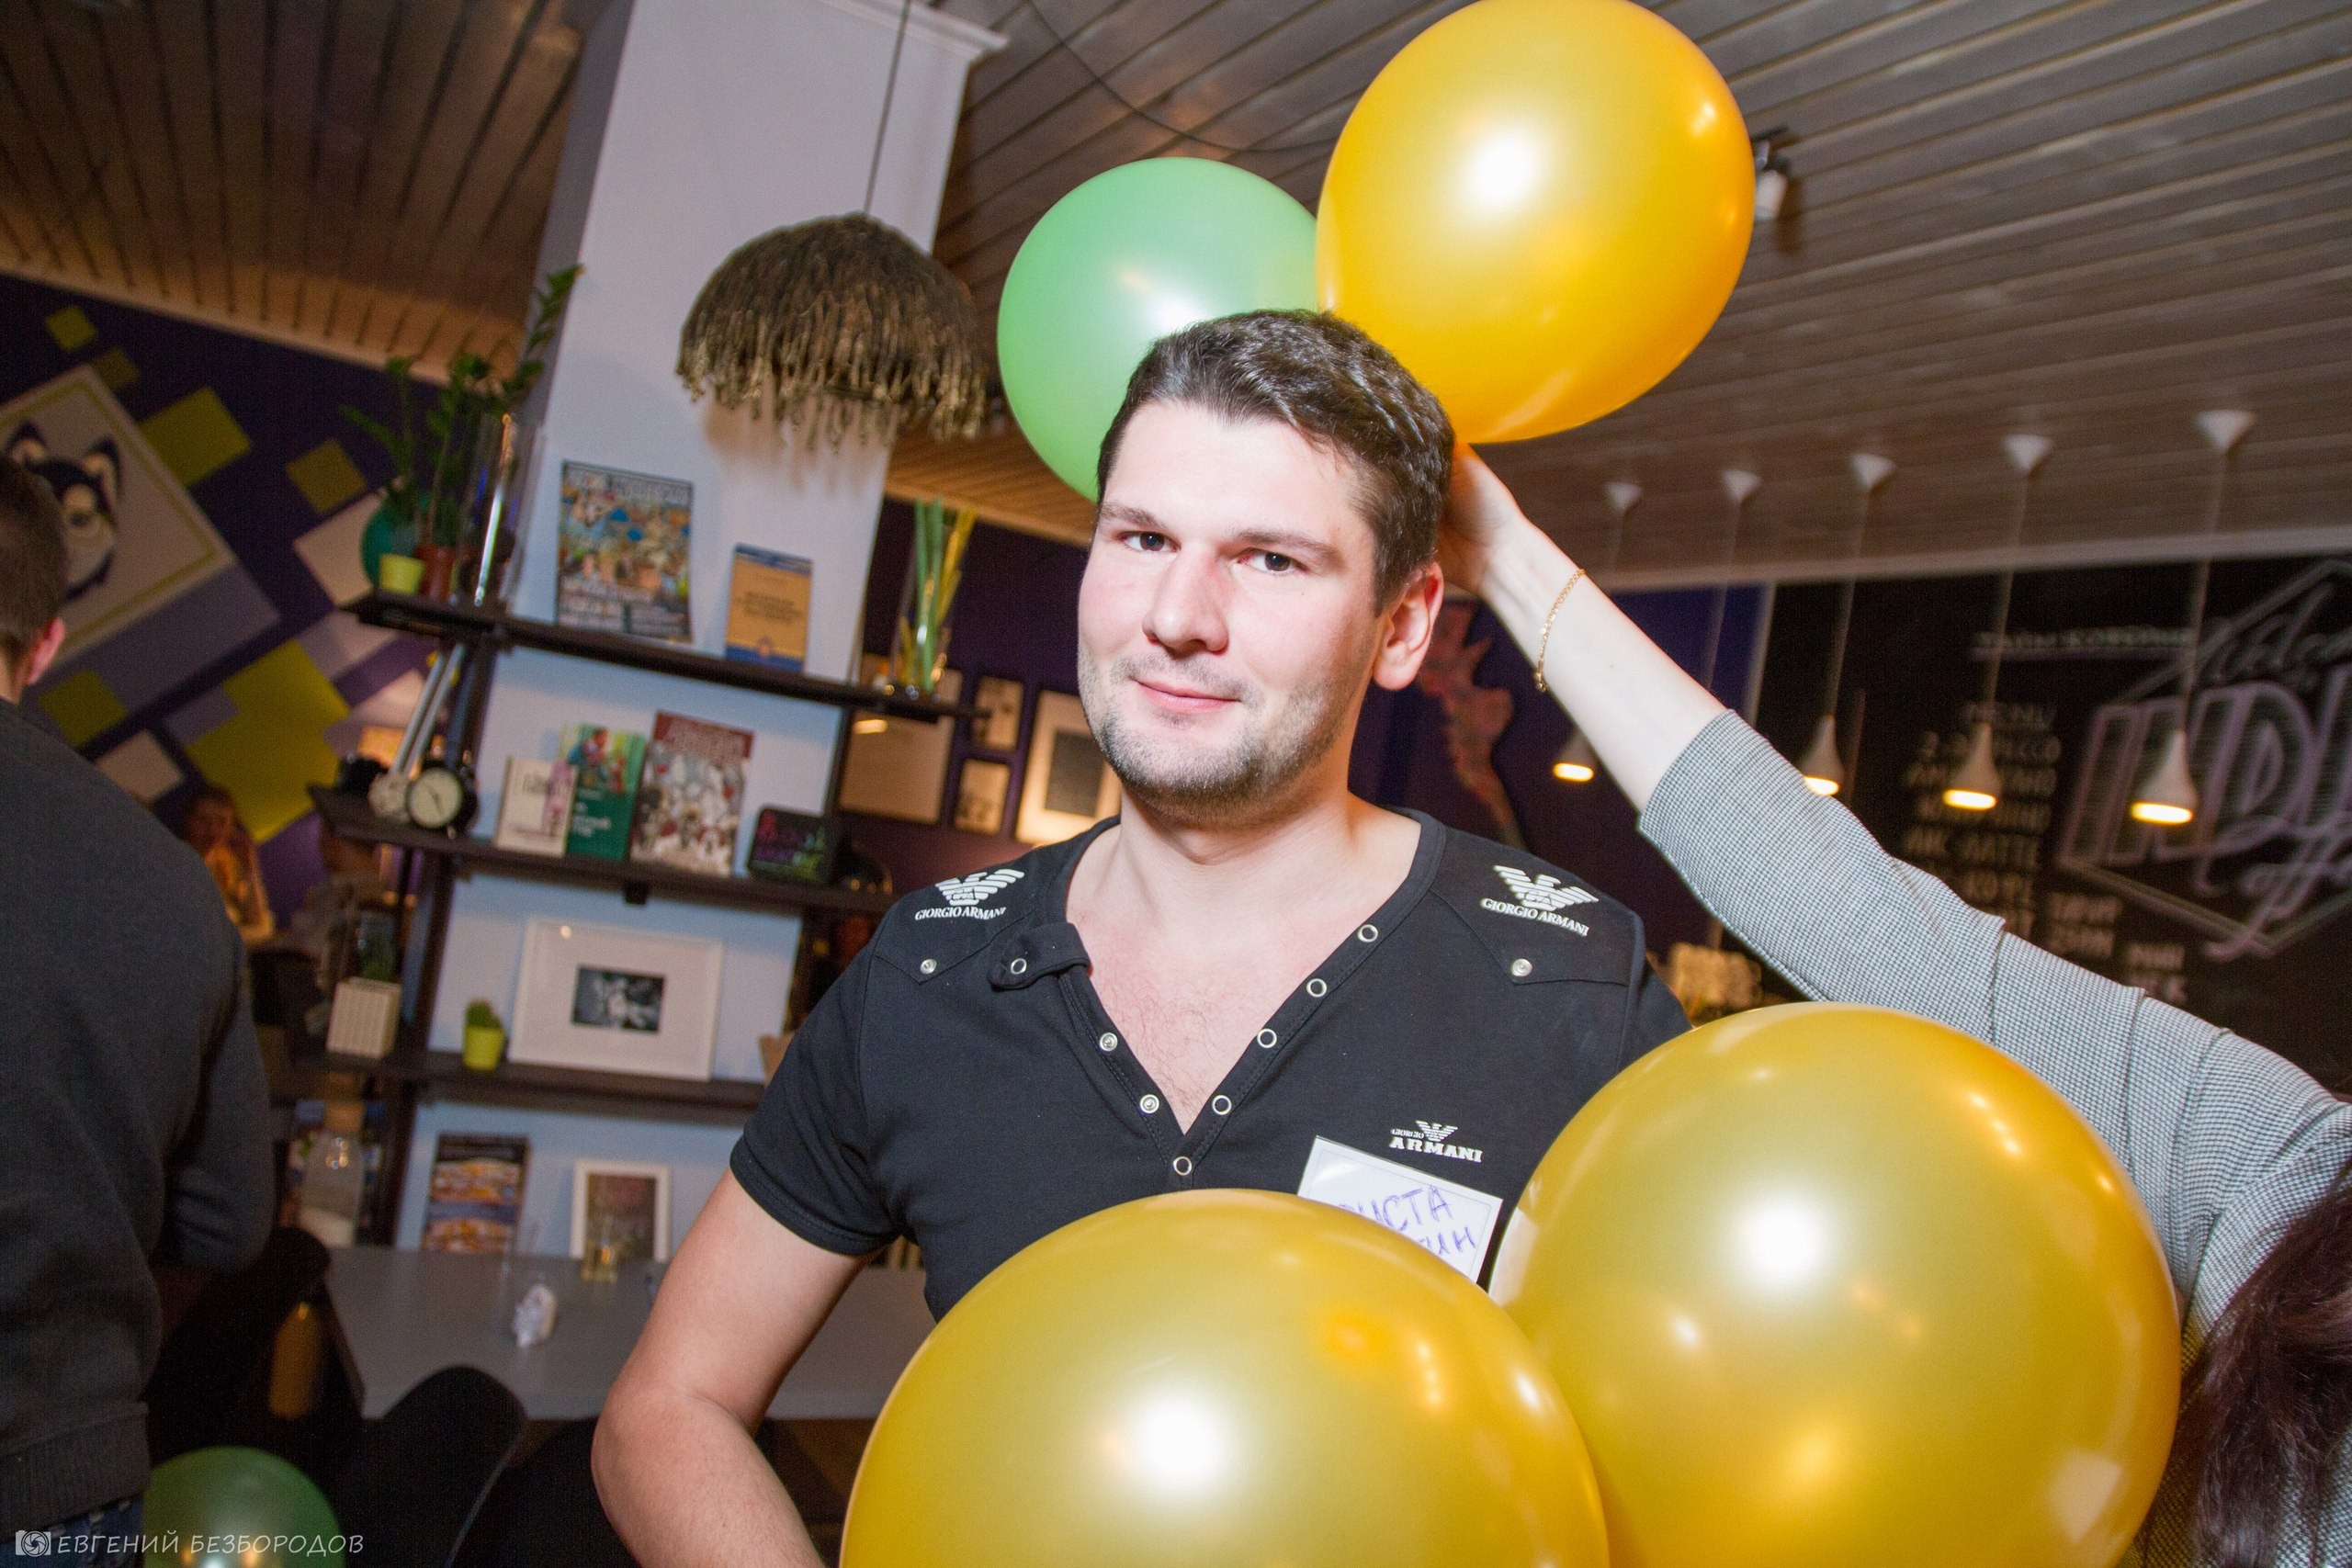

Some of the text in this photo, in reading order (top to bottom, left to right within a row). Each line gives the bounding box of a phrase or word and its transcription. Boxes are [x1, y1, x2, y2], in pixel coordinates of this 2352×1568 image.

[915, 907, 1007, 920] GIORGIO ARMANI
[1480, 897, 1589, 936] GIORGIO ARMANI
[1391, 1128, 1425, 1139] GIORGIO
[1388, 1136, 1483, 1163] ARMANI
